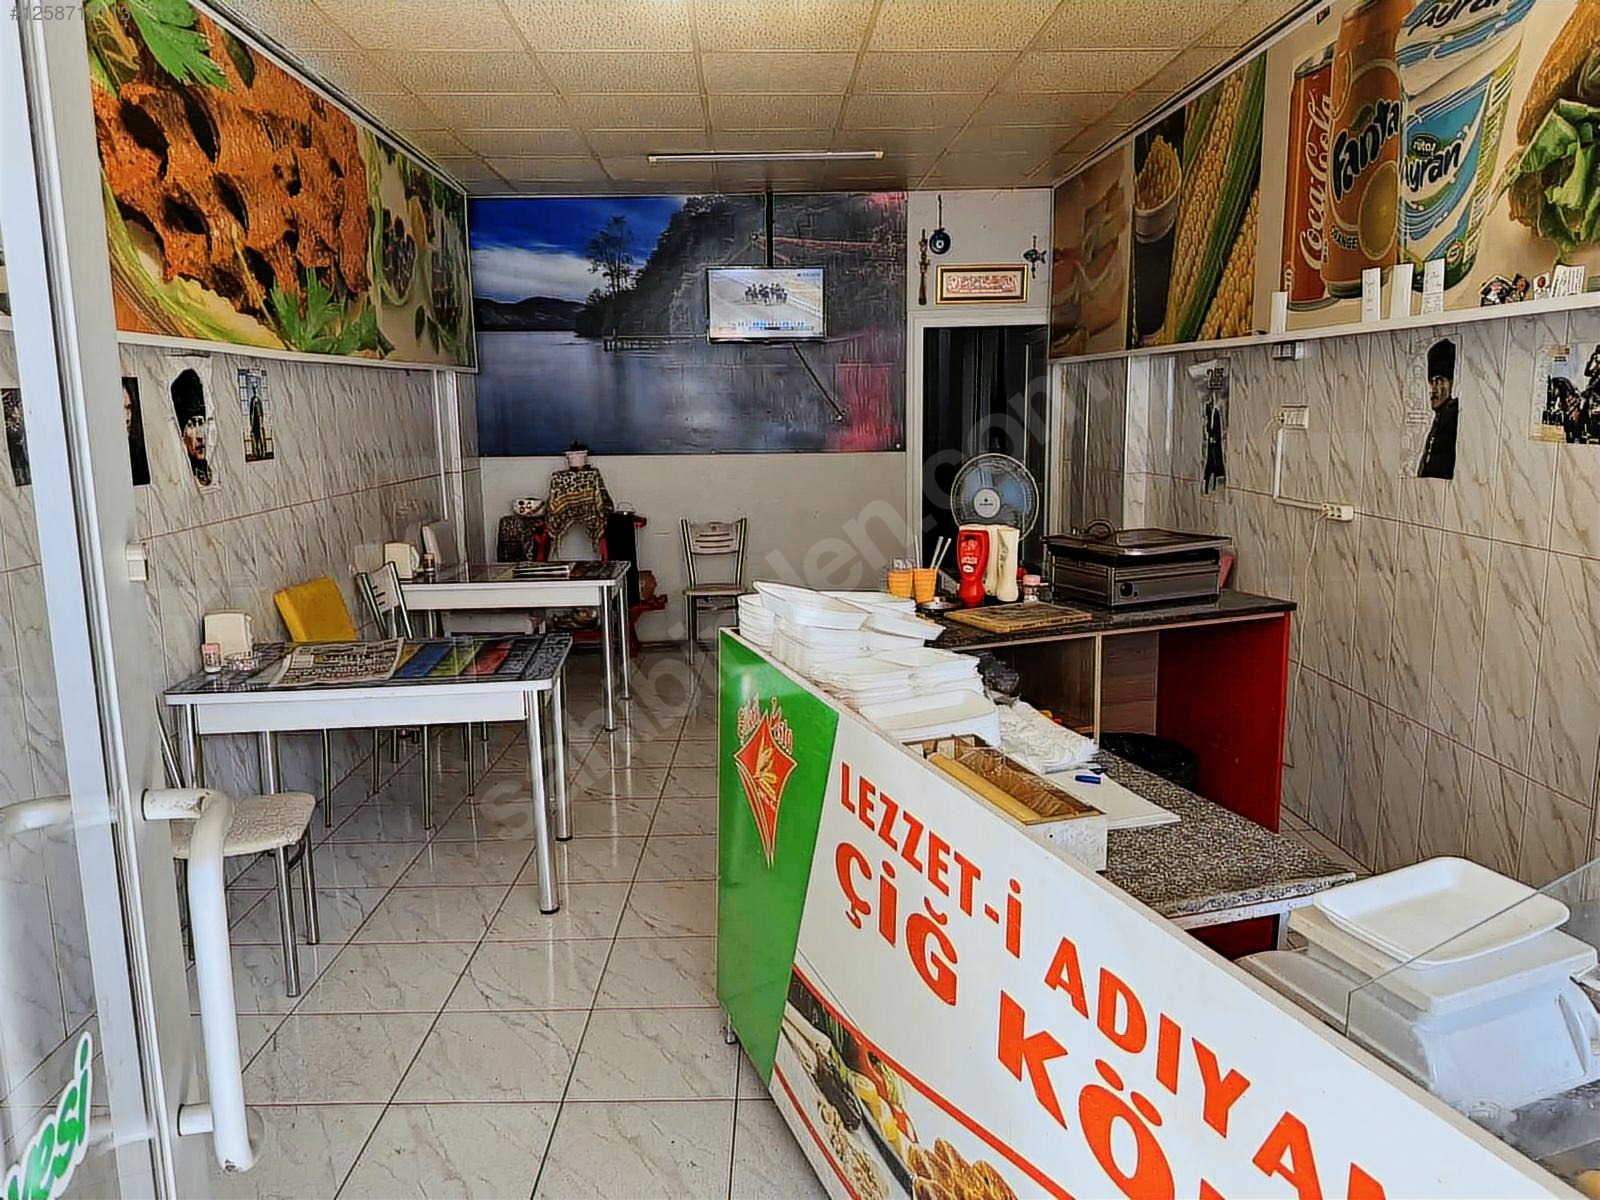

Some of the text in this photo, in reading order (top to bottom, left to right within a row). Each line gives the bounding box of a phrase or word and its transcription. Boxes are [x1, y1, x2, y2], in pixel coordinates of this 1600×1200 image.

[840, 762, 1021, 959] LEZZET-İ
[835, 842, 1226, 1200] ÇİĞ KÖ
